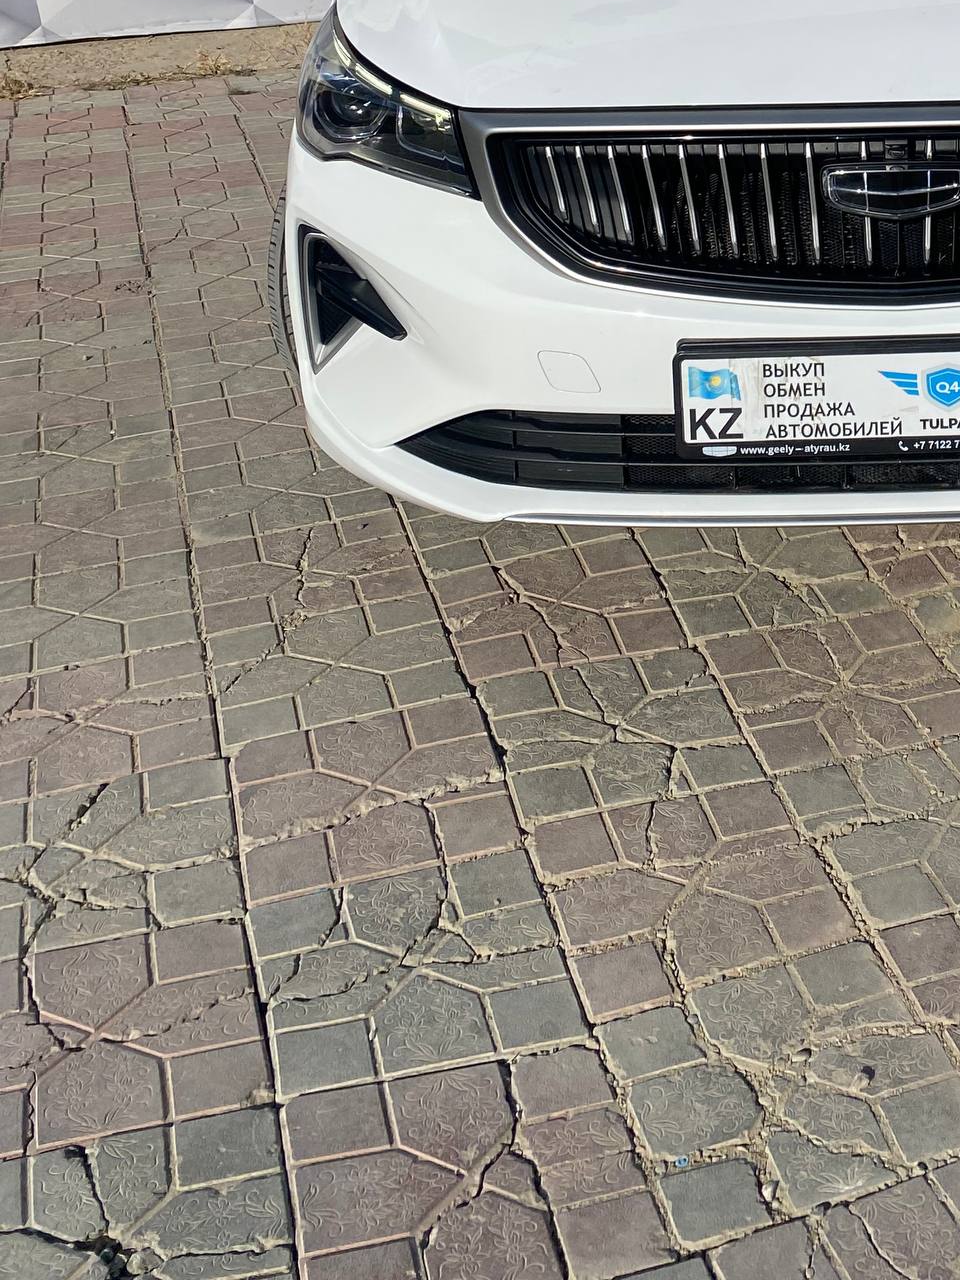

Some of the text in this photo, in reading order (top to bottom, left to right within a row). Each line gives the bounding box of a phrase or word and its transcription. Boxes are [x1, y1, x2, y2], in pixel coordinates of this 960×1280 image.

[762, 363, 825, 378] ВЫКУП
[763, 382, 826, 398] ОБМЕН
[936, 380, 960, 395] Q4
[763, 402, 856, 420] ПРОДАЖА
[689, 407, 744, 441] KZ
[765, 417, 903, 439] АВТОМОБИЛЕЙ
[913, 440, 925, 450] +7
[928, 440, 952, 450] 7122
